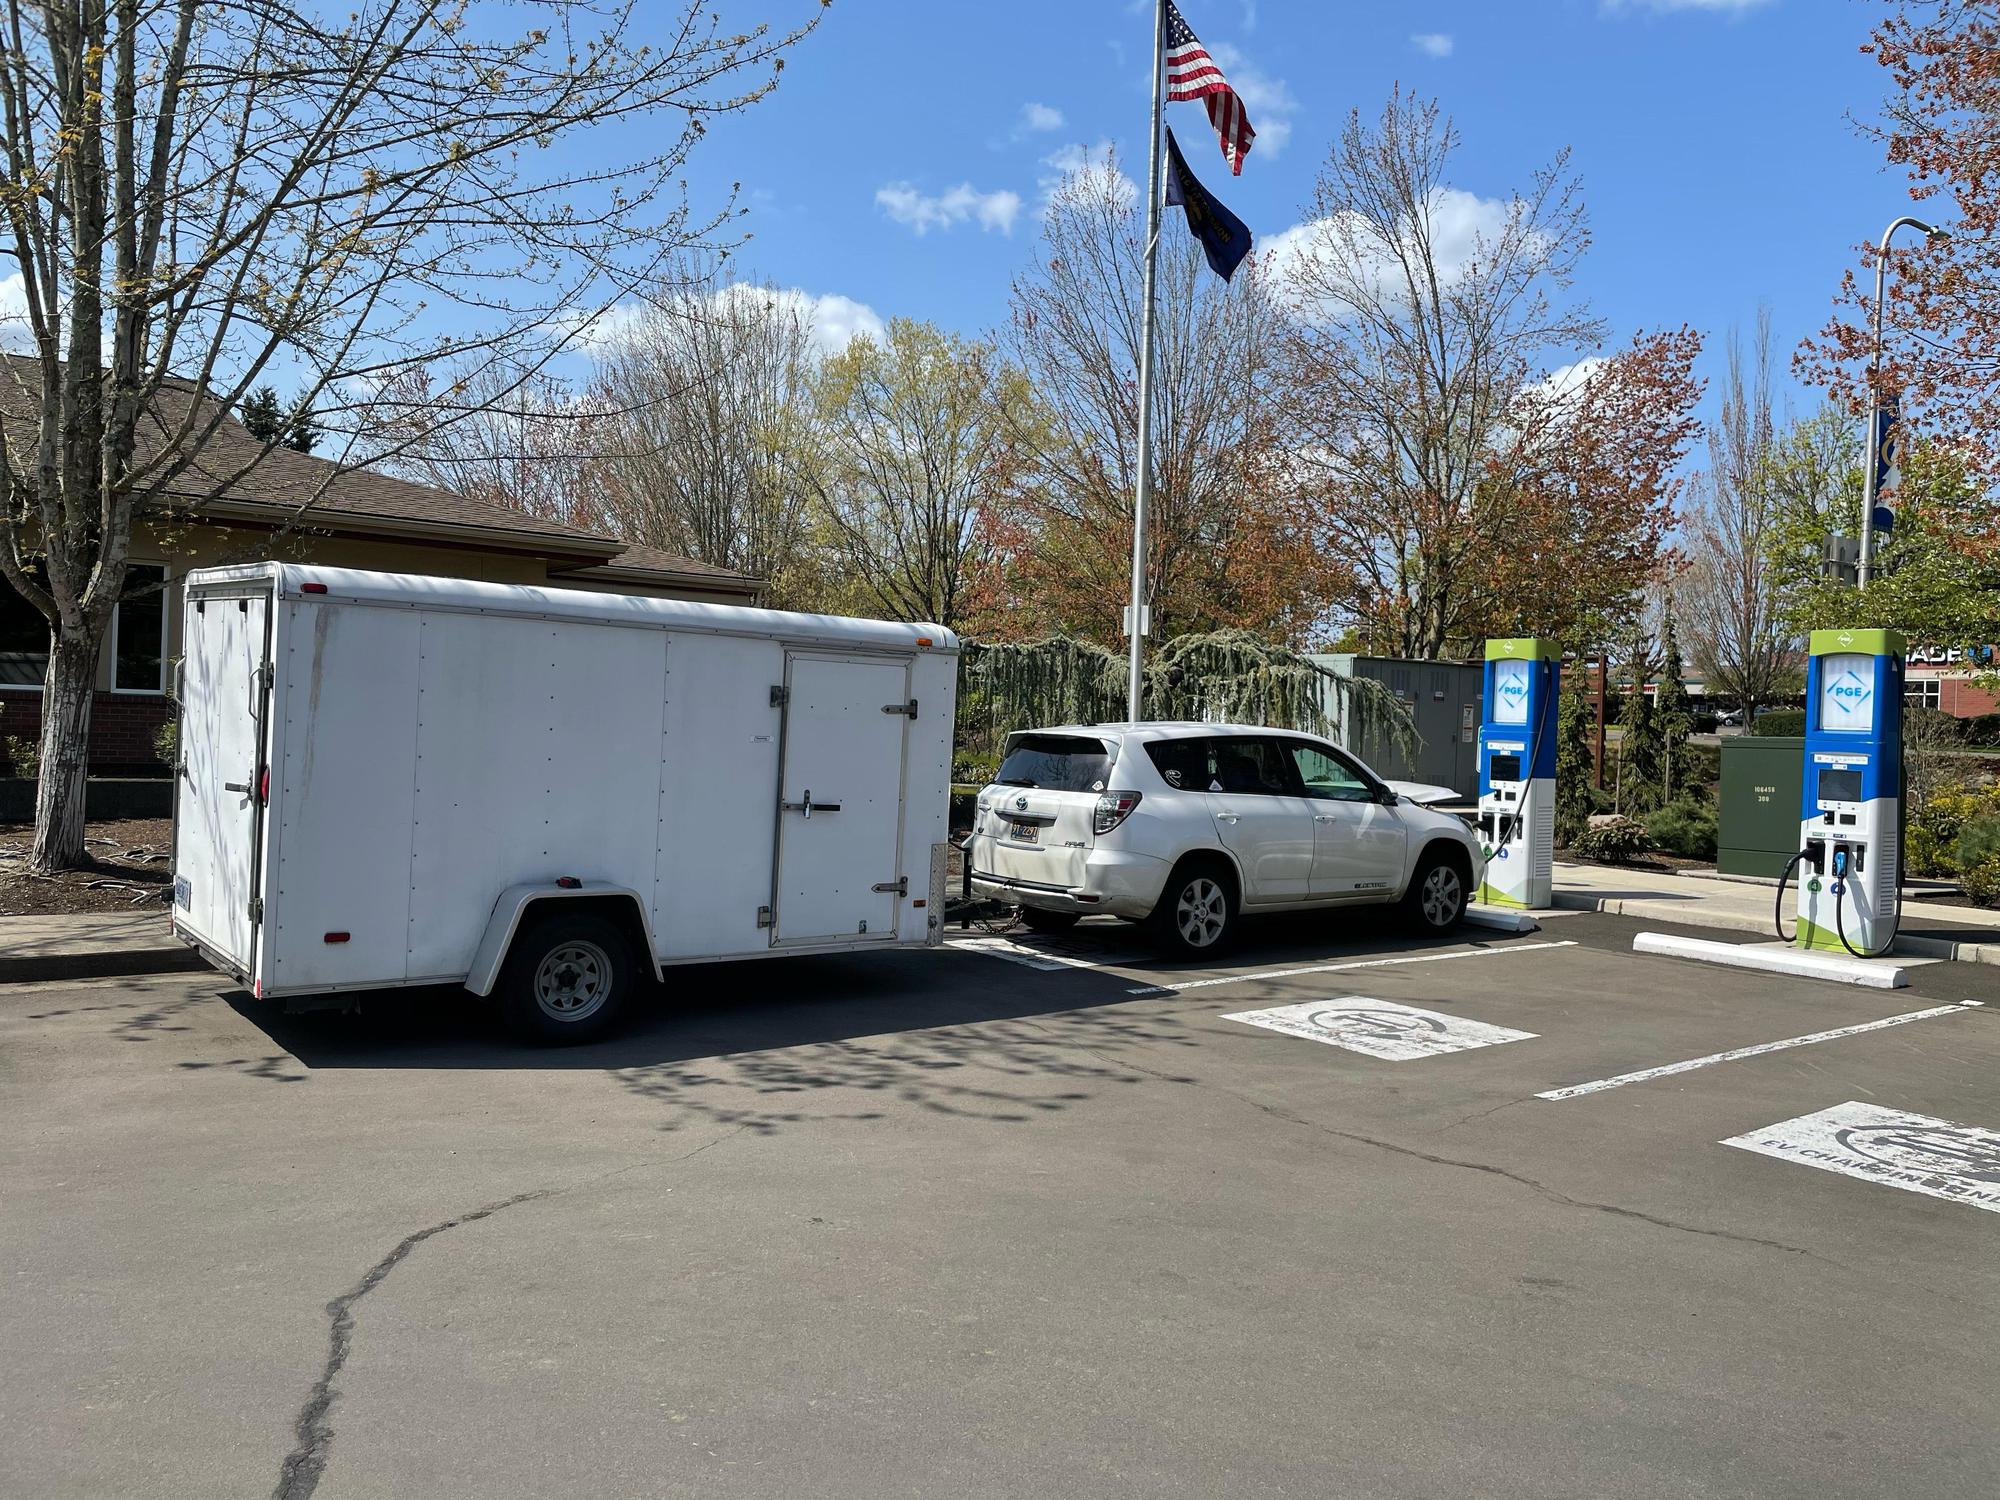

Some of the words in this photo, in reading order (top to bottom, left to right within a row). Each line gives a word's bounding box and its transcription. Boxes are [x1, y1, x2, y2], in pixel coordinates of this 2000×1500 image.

[1504, 687, 1523, 695] PGE
[1835, 687, 1862, 697] PGE
[1760, 1139, 1799, 1150] EV
